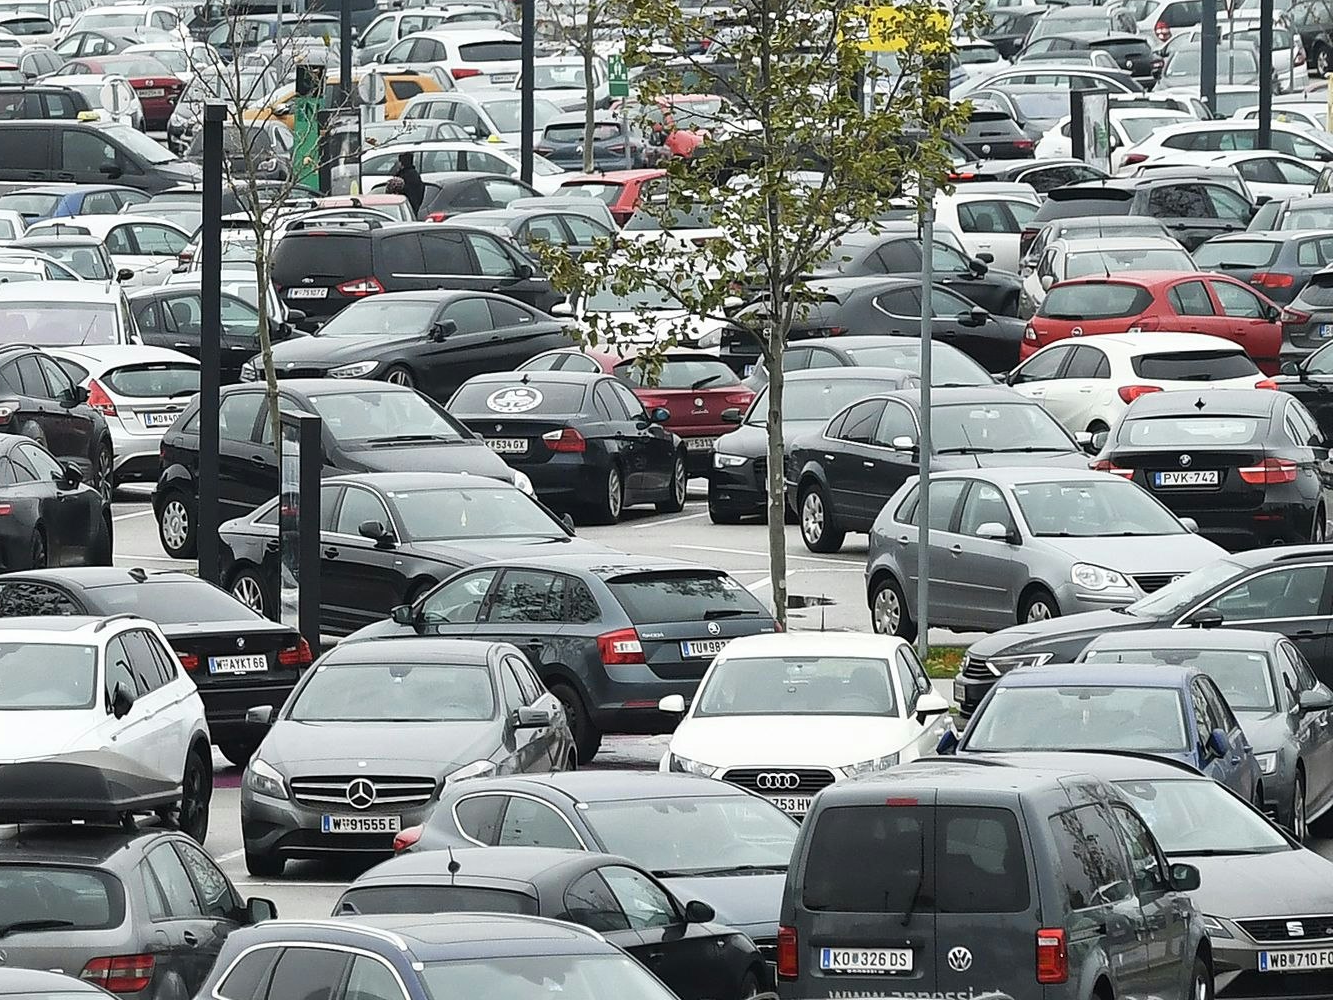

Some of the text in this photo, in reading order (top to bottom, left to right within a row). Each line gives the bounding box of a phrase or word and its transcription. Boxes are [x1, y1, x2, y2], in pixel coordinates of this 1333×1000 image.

[1164, 473, 1216, 483] PVK-742
[350, 818, 386, 831] 91555
[833, 952, 907, 966] KO 326 DS
[1270, 954, 1287, 968] WB
[1297, 952, 1317, 967] 710
